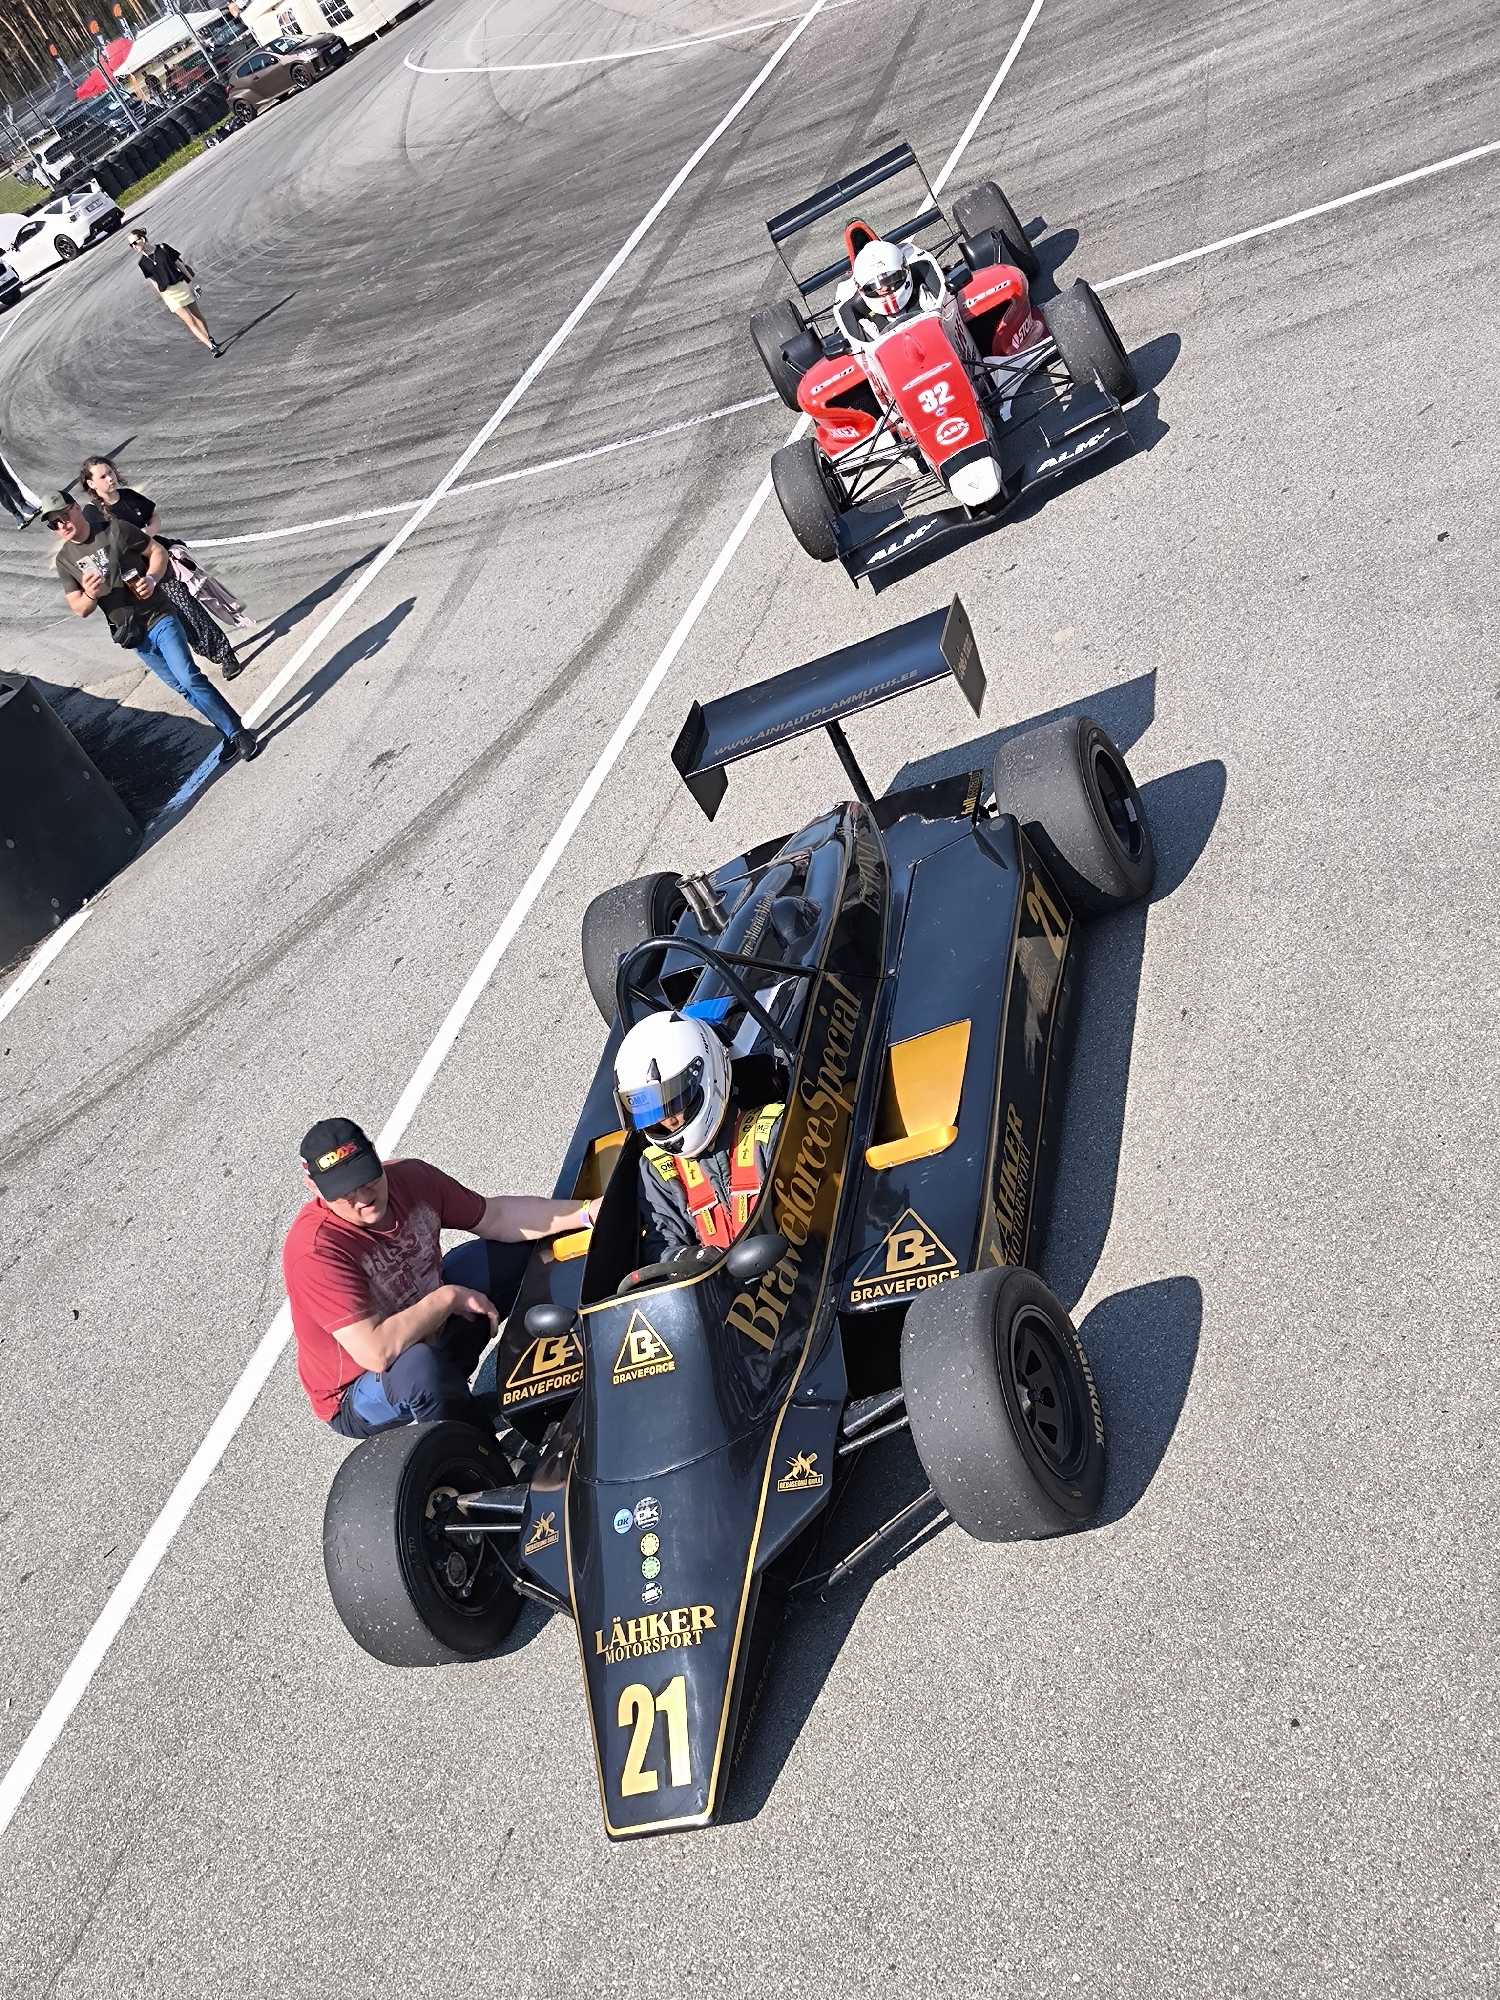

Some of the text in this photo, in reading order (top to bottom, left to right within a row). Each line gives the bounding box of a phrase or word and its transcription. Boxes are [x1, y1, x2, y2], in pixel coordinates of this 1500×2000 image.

[918, 382, 954, 414] 32
[1026, 871, 1067, 961] 21
[628, 1095, 647, 1105] OMP
[756, 1123, 770, 1132] MP
[660, 1160, 674, 1171] OM
[850, 1269, 960, 1303] BRAVEFORCE
[613, 1360, 676, 1385] BRAVEFORCE
[617, 1518, 630, 1527] OK
[595, 1604, 717, 1655] LÄHKER
[605, 1629, 703, 1666] MOTORSPORT
[617, 1674, 692, 1798] 21
